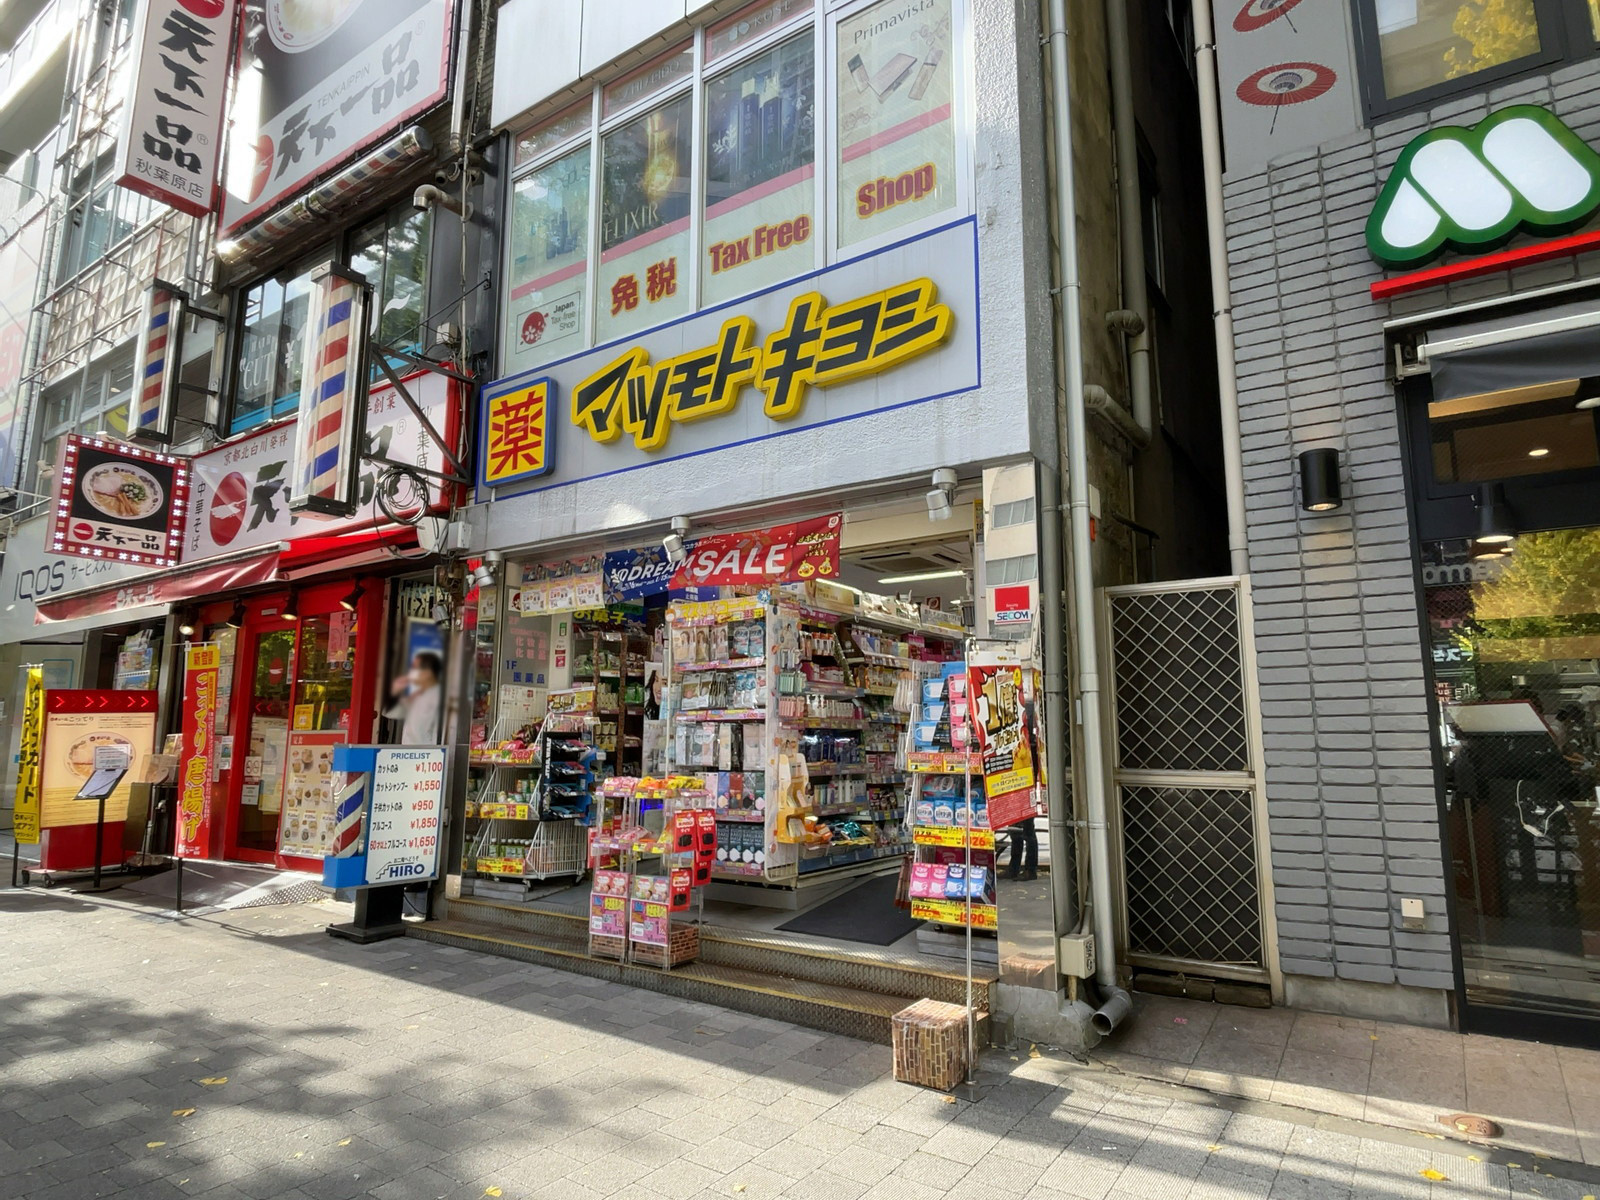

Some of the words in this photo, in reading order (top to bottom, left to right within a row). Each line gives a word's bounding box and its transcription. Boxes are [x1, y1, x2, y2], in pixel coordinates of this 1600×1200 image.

[854, 0, 936, 45] Primavista
[142, 8, 216, 174] 天下一品
[273, 30, 421, 182] 天下一品
[135, 157, 205, 198] 秋葉原店
[857, 162, 936, 218] Shop
[602, 202, 660, 243] ELIXIR
[710, 234, 752, 275] Tax
[754, 213, 811, 261] Free
[610, 257, 678, 316] 免税
[573, 284, 945, 444] マツモトキヨシ
[490, 391, 543, 476] 薬
[95, 526, 160, 551] 天下一品
[693, 543, 788, 576] SALE
[14, 560, 66, 602] IQOS
[996, 611, 1029, 621] SECOM
[377, 764, 398, 774] カットのみ
[415, 762, 442, 774] ¥1,100
[391, 752, 431, 760] PRICELIST
[374, 802, 403, 813] 子供カットのみ
[412, 800, 433, 811] ¥950
[376, 782, 408, 792] カットシャンプー
[413, 780, 440, 792] ¥1,550
[372, 821, 392, 831] フルコース
[410, 818, 437, 829] ¥1,850
[408, 836, 435, 848] ¥1,650
[389, 863, 425, 878] HIRO
